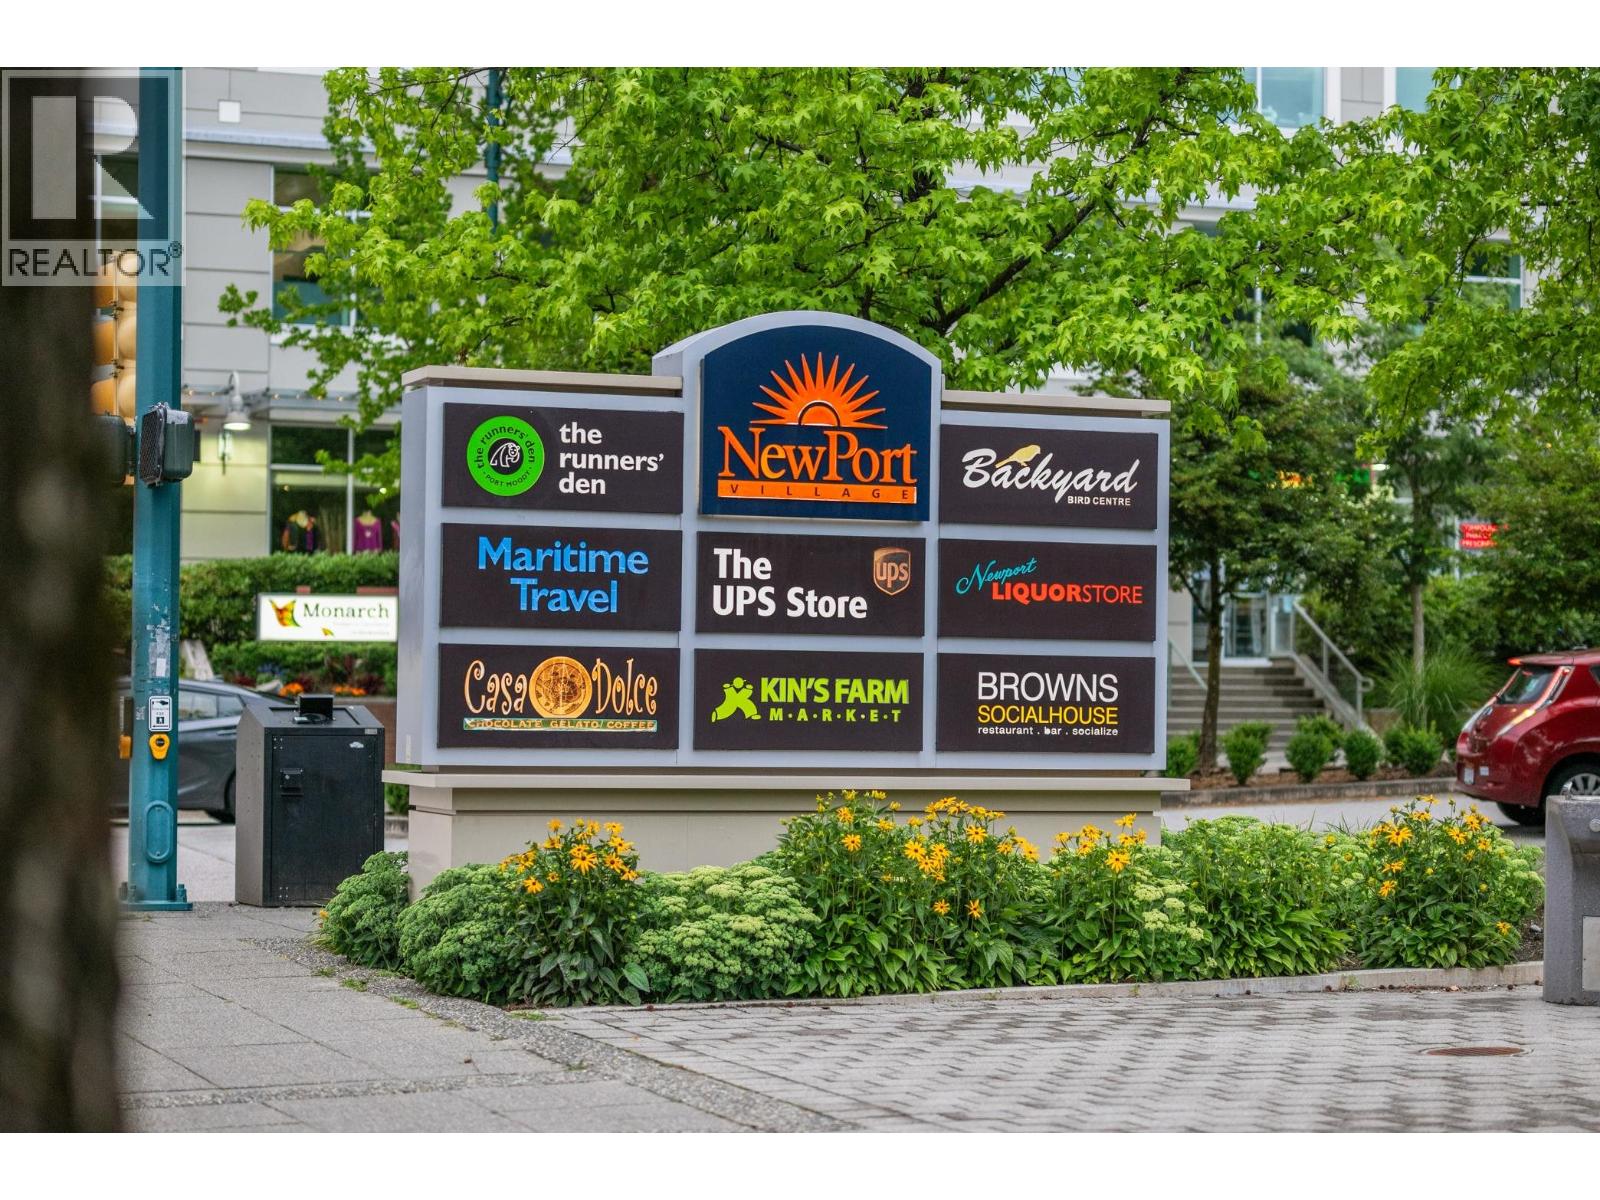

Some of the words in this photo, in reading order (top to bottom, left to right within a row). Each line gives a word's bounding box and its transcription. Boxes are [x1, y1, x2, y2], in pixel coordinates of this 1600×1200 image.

[559, 421, 603, 444] the
[474, 447, 484, 470] the
[525, 440, 536, 464] den
[559, 452, 664, 472] runners'
[717, 426, 918, 484] NewPort
[486, 474, 504, 487] PORT
[506, 471, 531, 487] MOODY
[558, 471, 606, 495] den
[961, 448, 1140, 503] Backyard
[730, 483, 909, 500] VILLAGE
[1067, 495, 1091, 505] BIRD
[1093, 496, 1131, 506] CENTRE
[478, 536, 649, 574] Maritime
[713, 547, 772, 580] The
[875, 562, 909, 588] ups
[955, 557, 1038, 595] Newport
[510, 577, 618, 613] Travel
[712, 584, 776, 617] UPS
[786, 586, 868, 619] Store
[303, 603, 390, 619] Monarch
[464, 659, 527, 715] Casa
[592, 658, 658, 716] Dolce
[760, 677, 830, 704] KIN'S
[834, 678, 909, 704] FARM
[977, 671, 1119, 703] BROWNS
[467, 718, 543, 729] CHOCOLATE
[606, 720, 656, 730] COFFEE
[977, 705, 1119, 725] SOCIALHOUSE
[978, 726, 1034, 735] restaurant
[1044, 726, 1062, 736] bar
[1072, 727, 1118, 736] socialize
